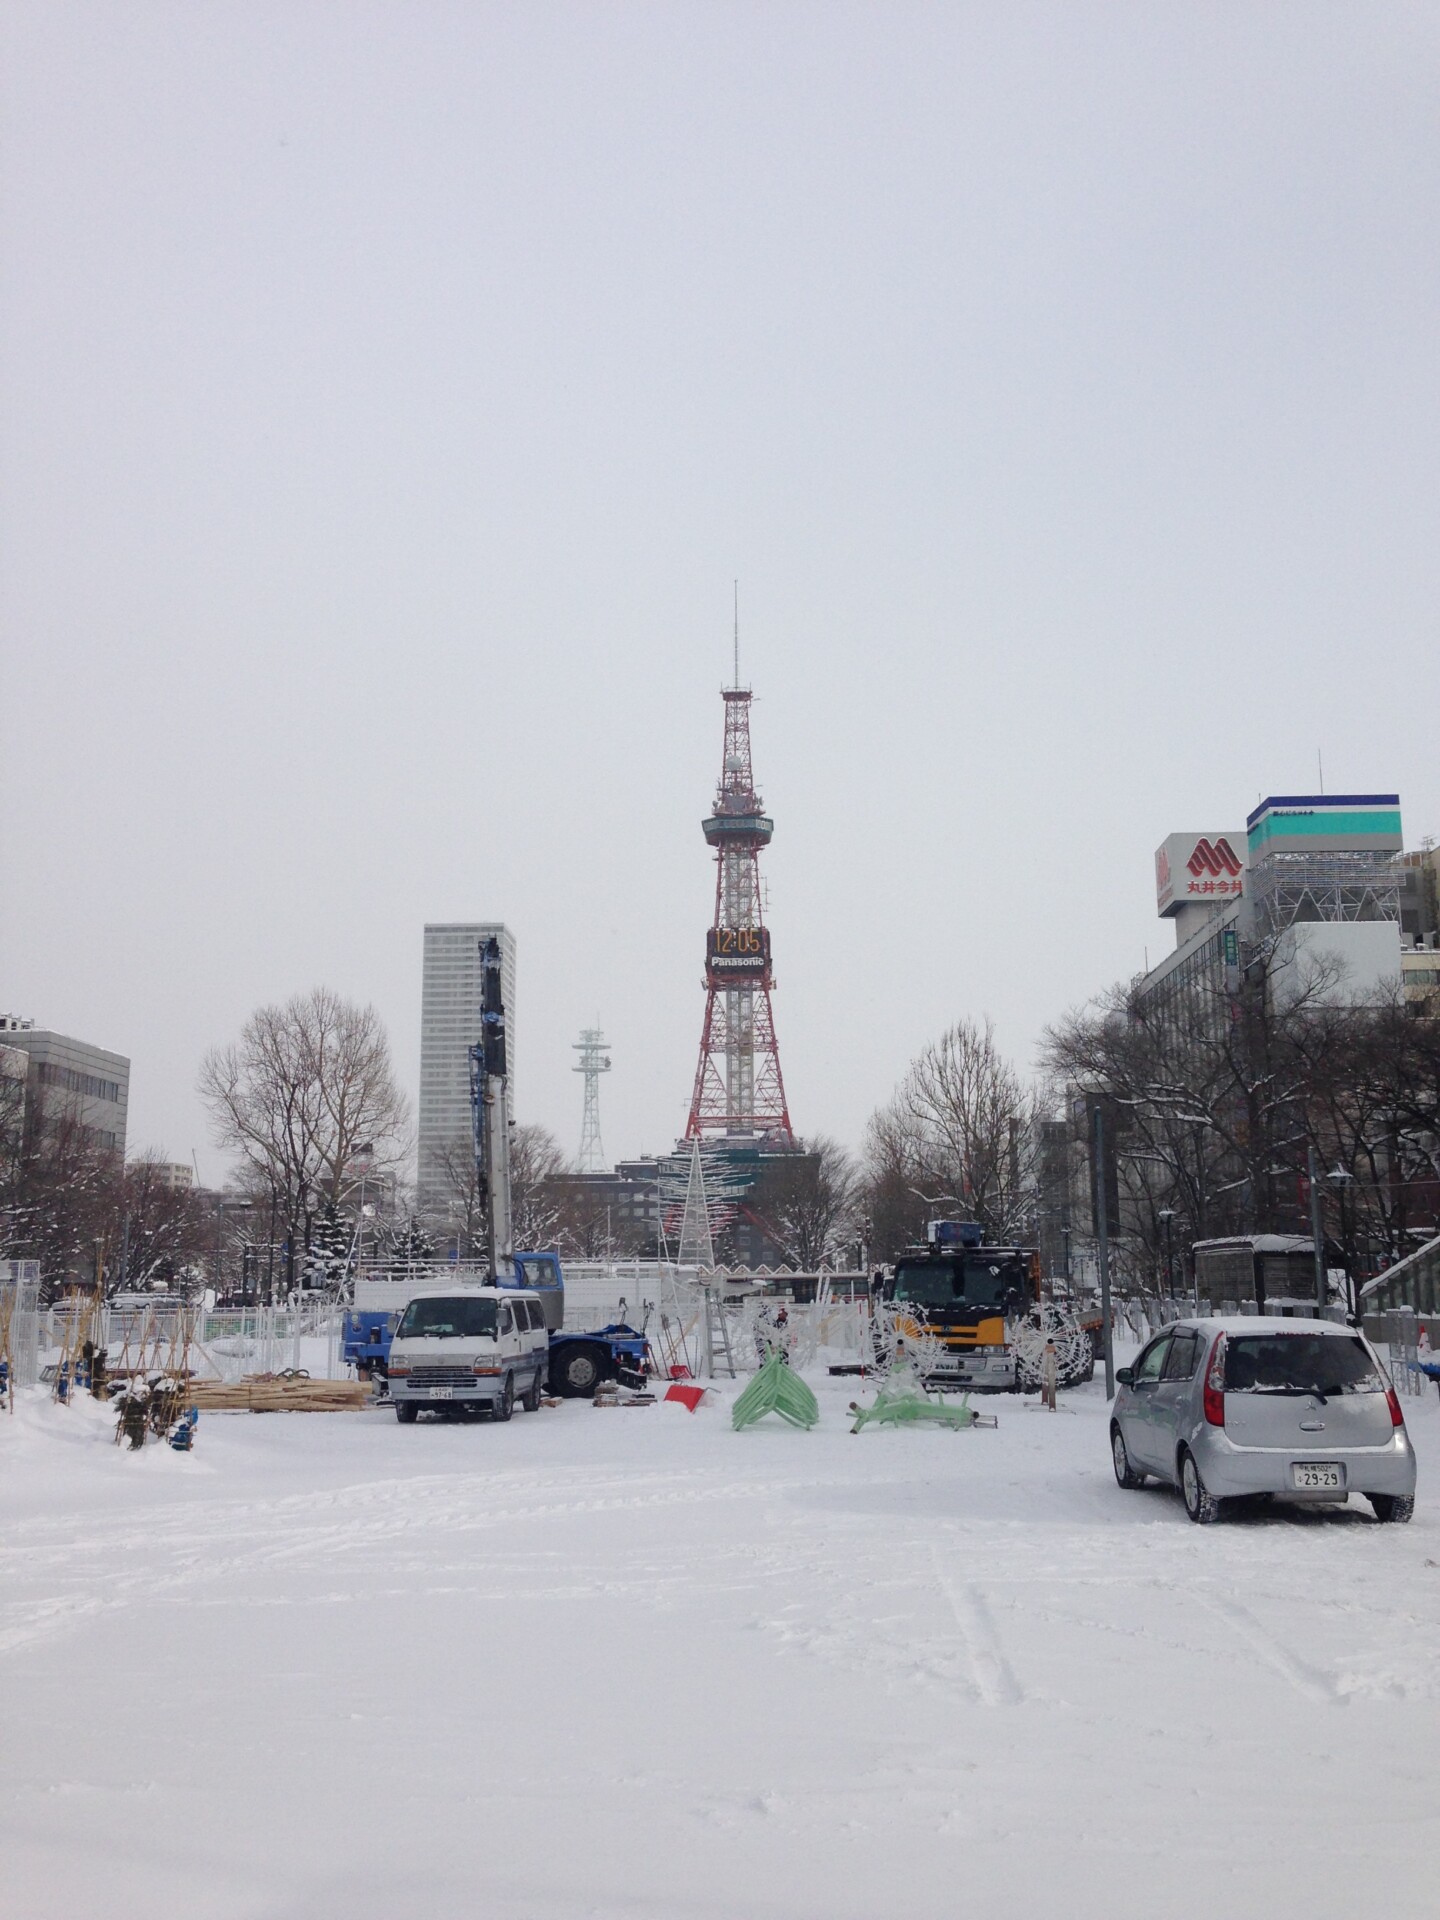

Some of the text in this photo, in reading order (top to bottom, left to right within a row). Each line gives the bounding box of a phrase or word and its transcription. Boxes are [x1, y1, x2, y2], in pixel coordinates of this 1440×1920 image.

[1187, 880, 1243, 894] 丸井今井
[715, 928, 761, 954] 12:05
[711, 957, 764, 967] Panasonic
[1304, 1473, 1338, 1485] 29-29
